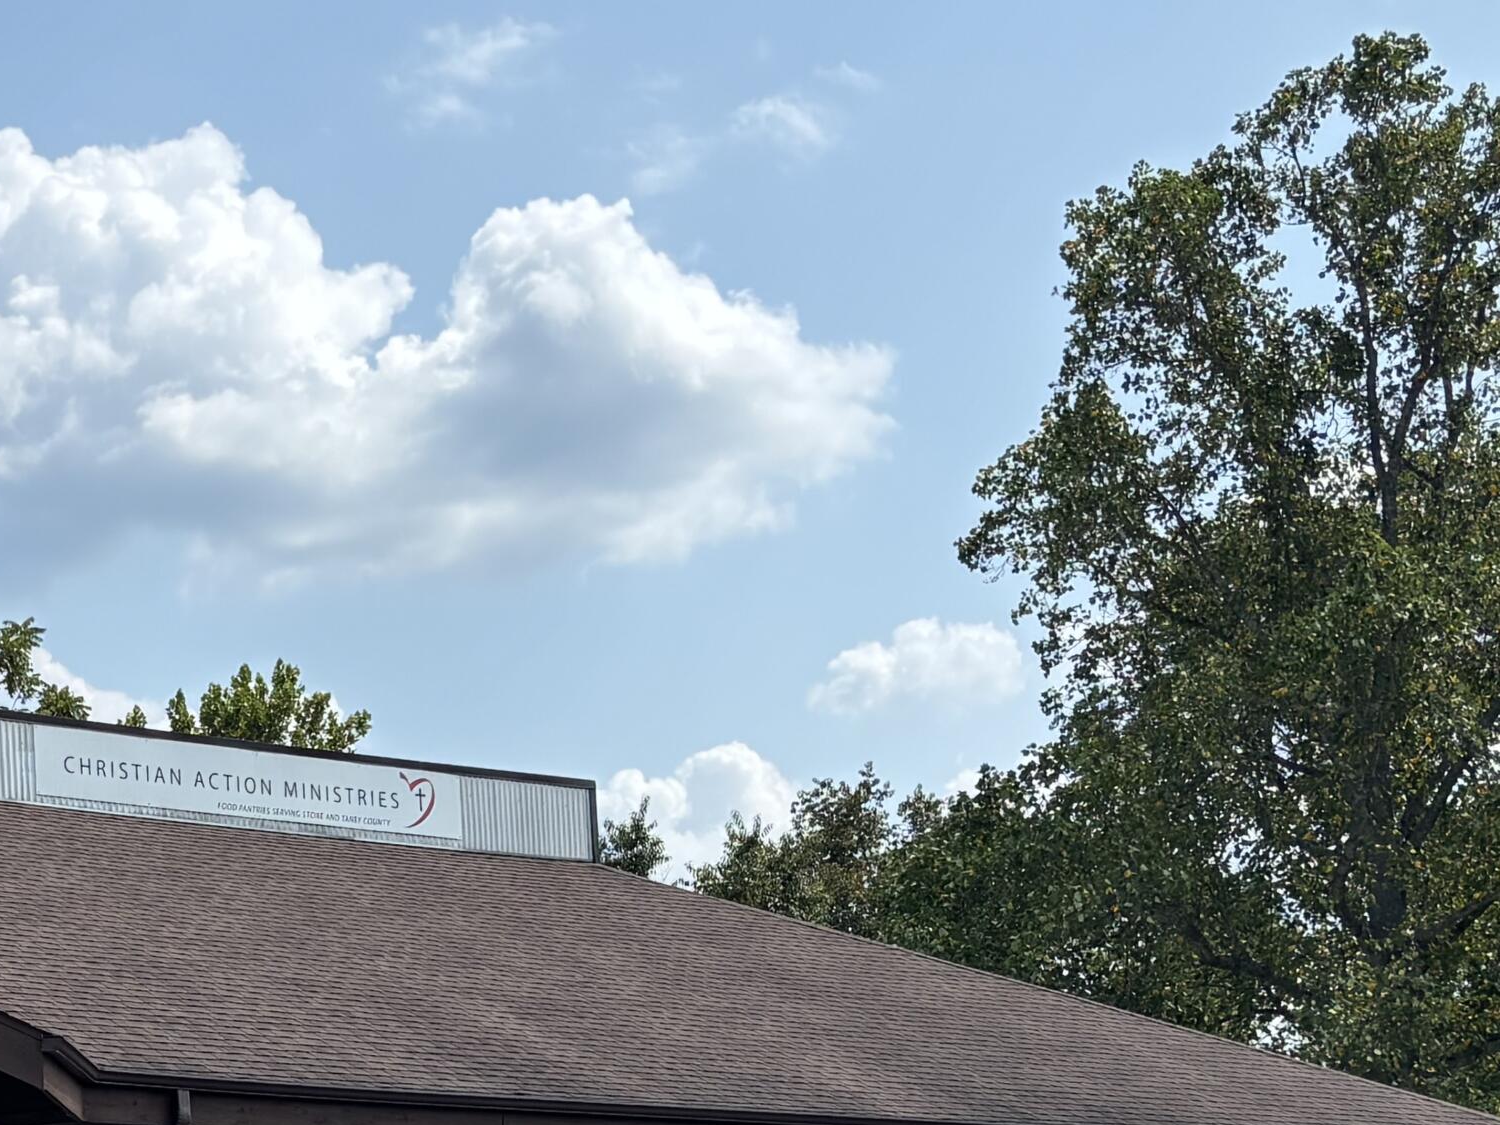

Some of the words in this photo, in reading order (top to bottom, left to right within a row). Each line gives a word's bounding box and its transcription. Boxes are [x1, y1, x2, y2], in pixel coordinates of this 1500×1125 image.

[63, 755, 182, 786] CHRISTIAN
[194, 770, 272, 796] ACTION
[284, 780, 399, 809] MINISTRIES
[217, 802, 238, 811] FOOD
[239, 804, 271, 815] PANTRIES
[272, 807, 301, 818] SERVING
[325, 813, 340, 822] AND
[363, 817, 391, 827] COUNTY
